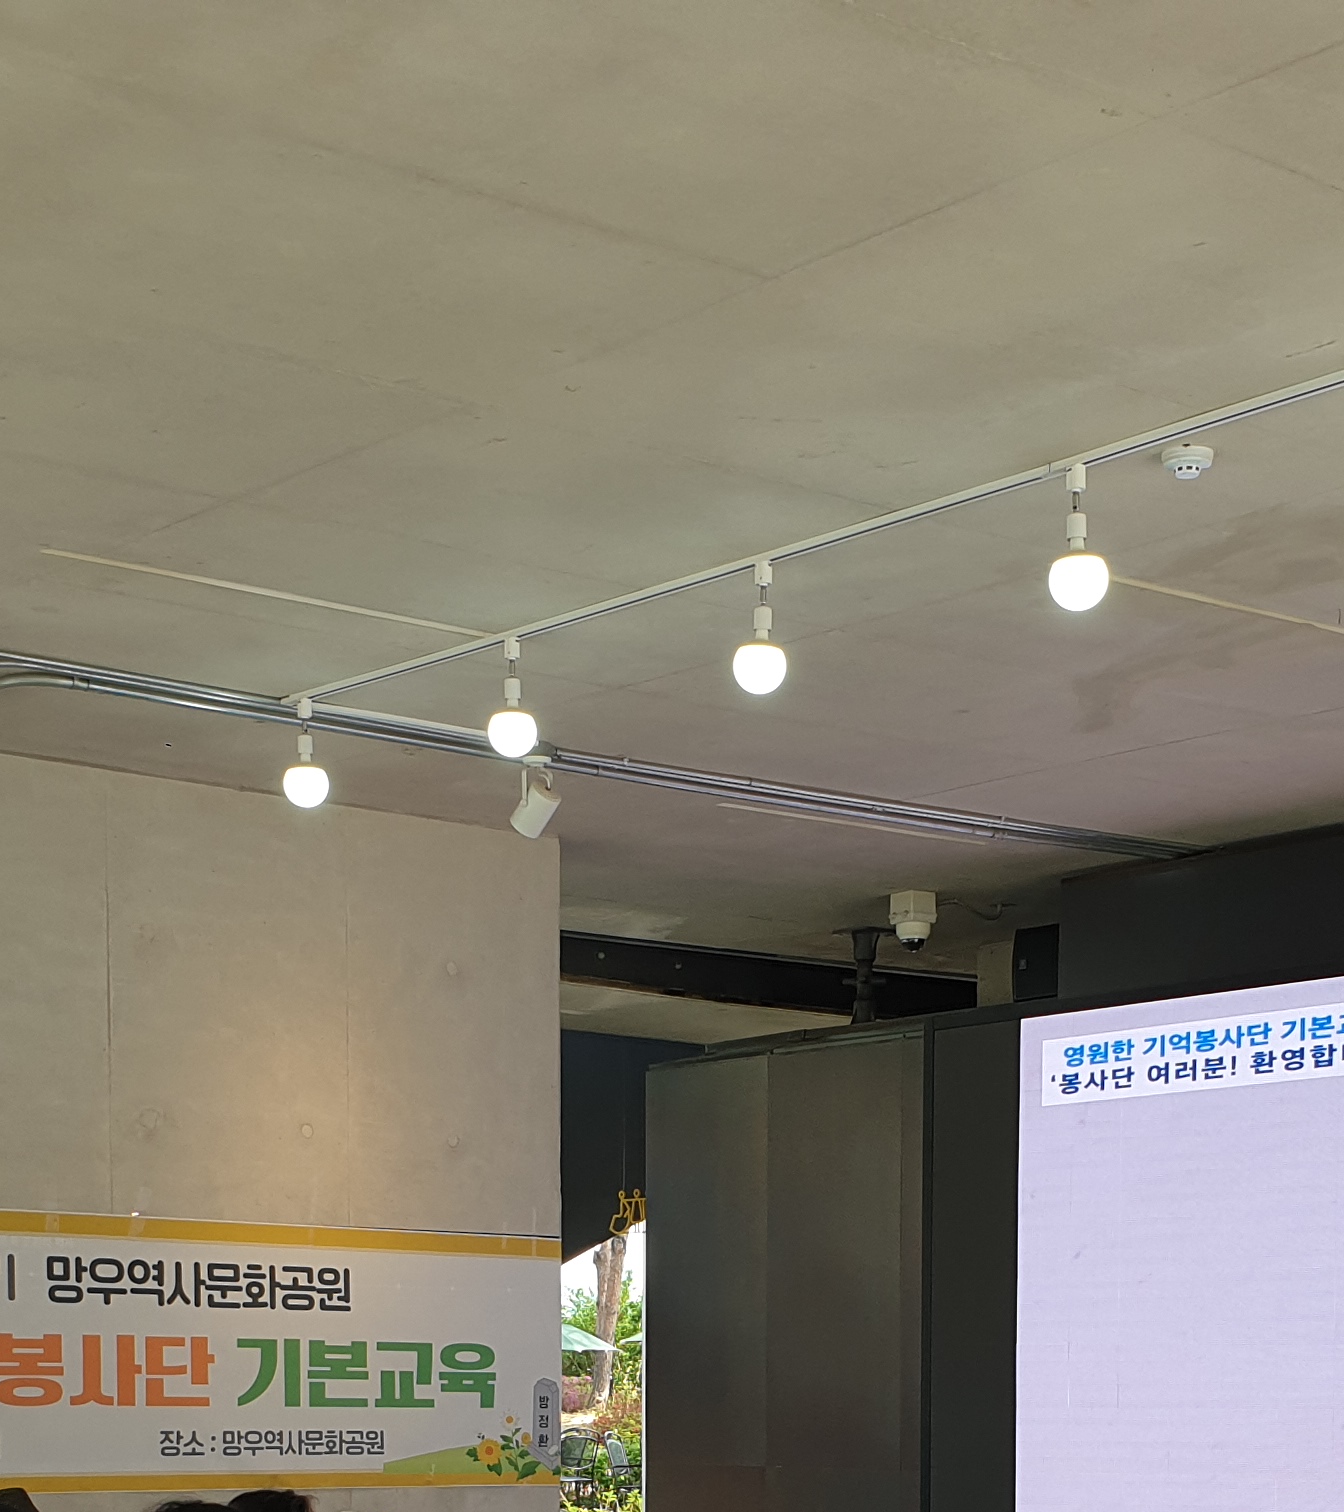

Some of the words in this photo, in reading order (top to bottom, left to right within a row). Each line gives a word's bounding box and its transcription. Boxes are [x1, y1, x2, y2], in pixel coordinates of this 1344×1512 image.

[1063, 1039, 1135, 1067] 영원한
[1142, 1021, 1272, 1059] 기억봉사단
[1147, 1055, 1237, 1085] 여러분!
[46, 1255, 352, 1312] 망우역사문화공원
[236, 1338, 497, 1409] 기본교육
[222, 1430, 385, 1457] 망우역사문화공원
